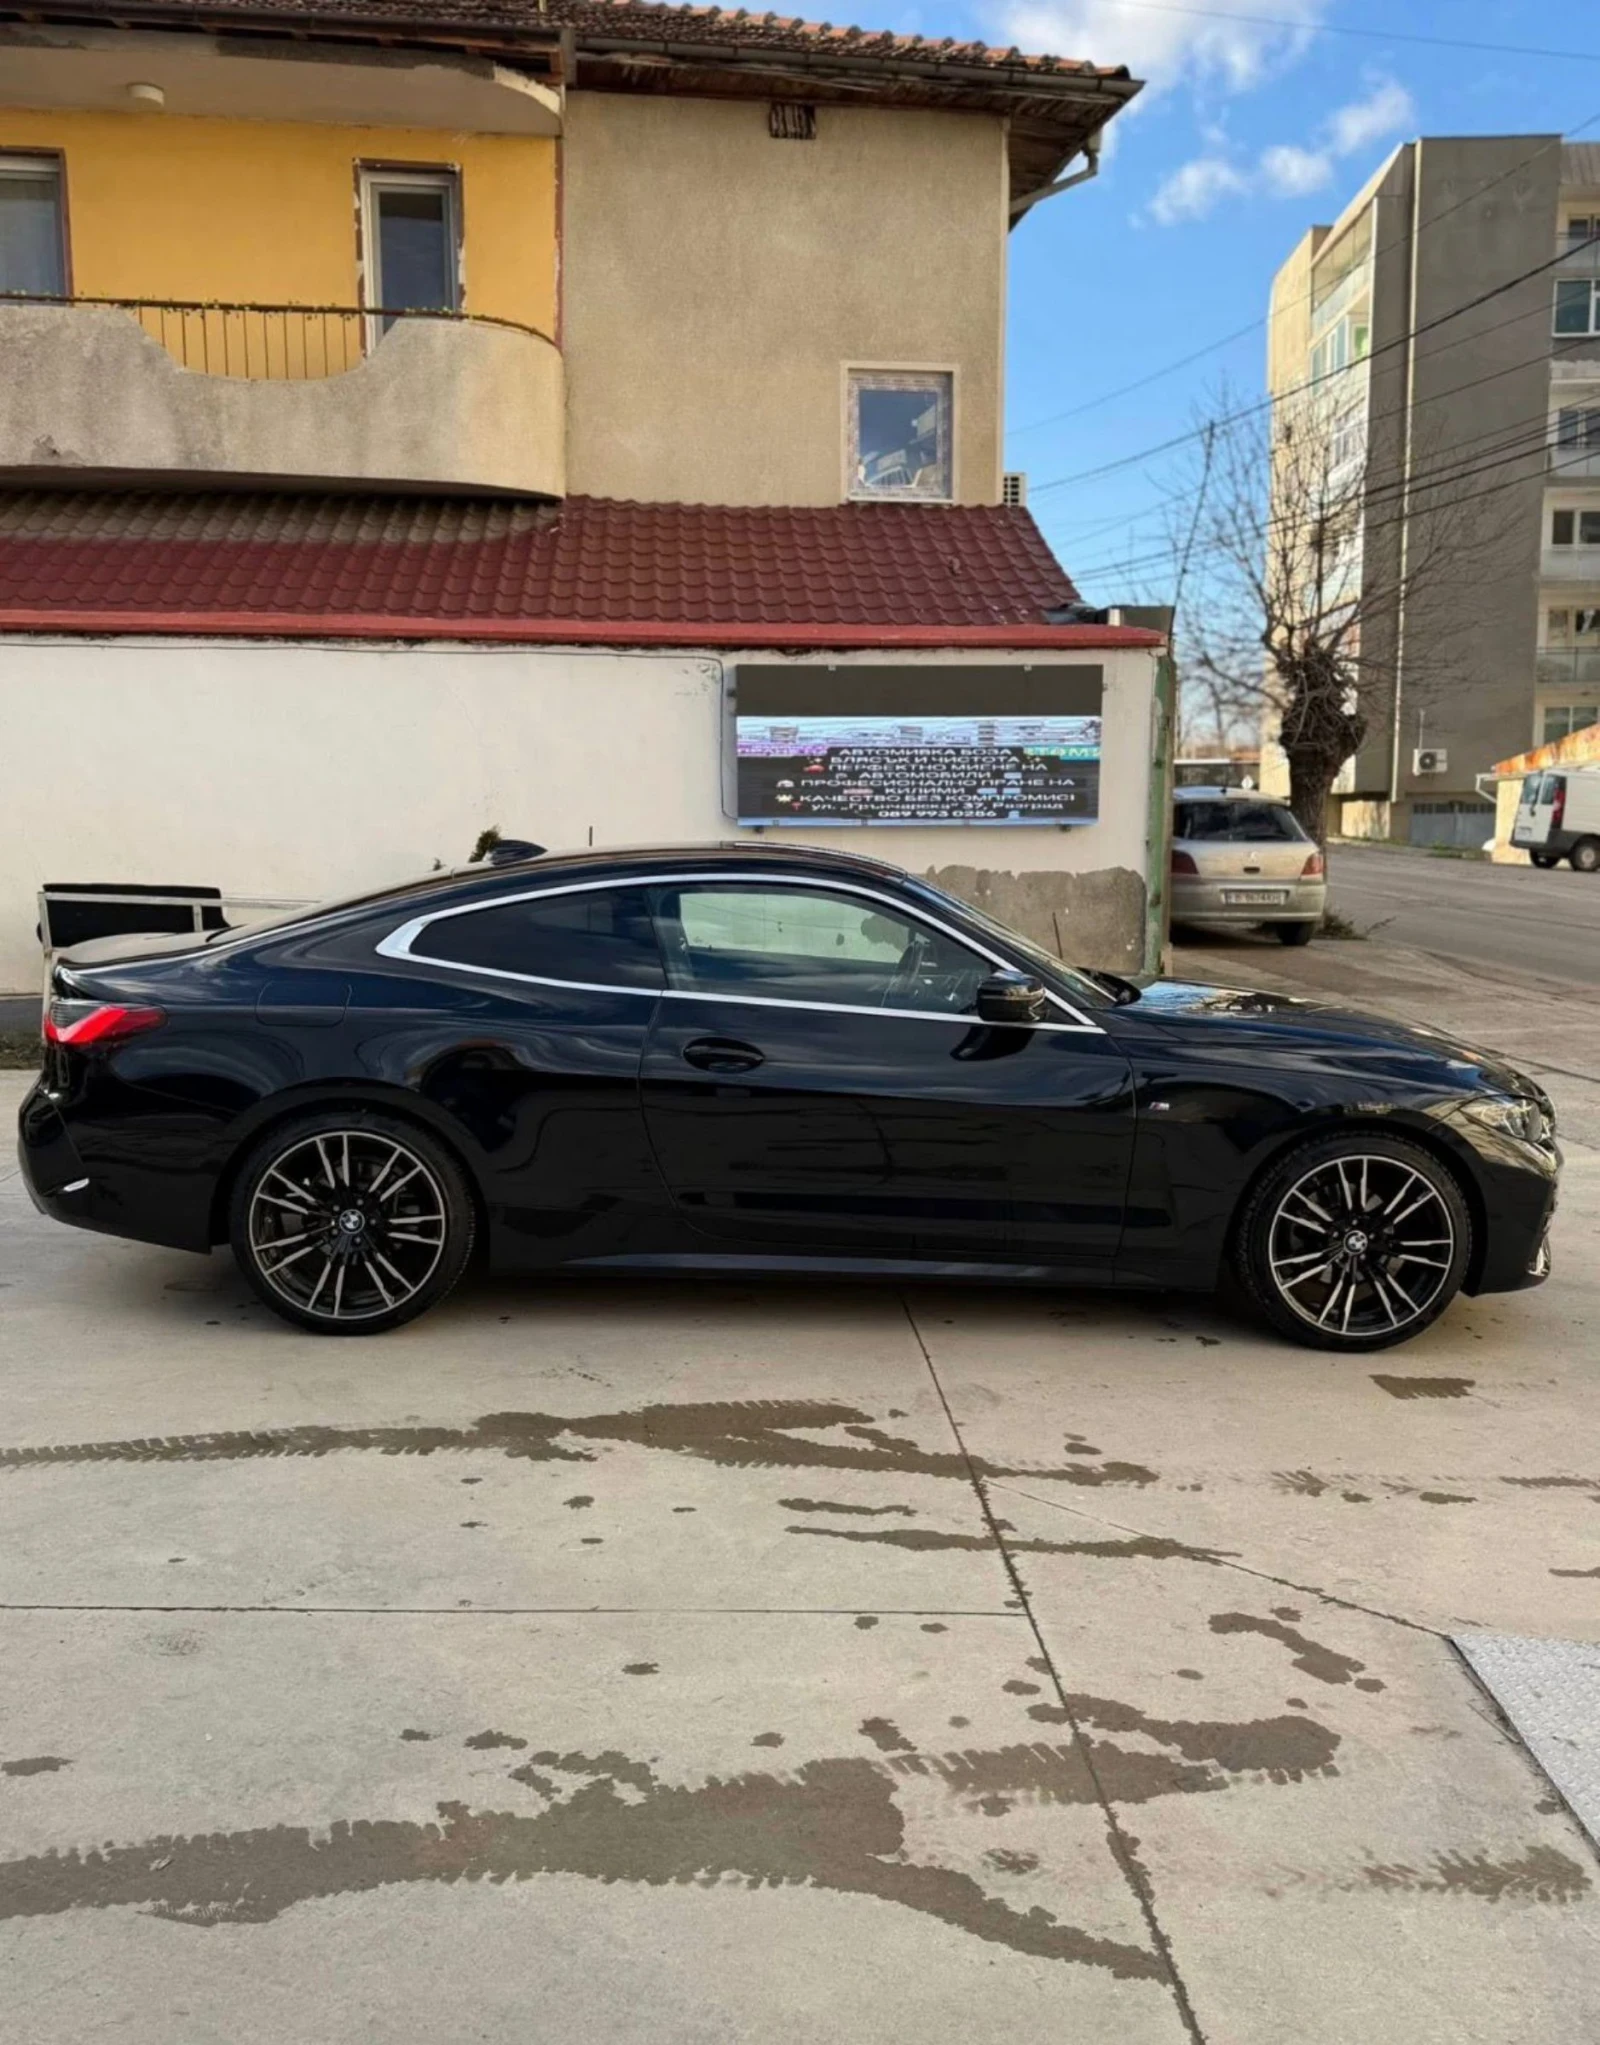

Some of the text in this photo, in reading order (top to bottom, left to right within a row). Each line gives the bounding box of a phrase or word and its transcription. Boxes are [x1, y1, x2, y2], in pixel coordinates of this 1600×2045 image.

[839, 748, 956, 756] АВТОМИВКА
[914, 756, 927, 764] И
[931, 756, 1020, 764] ЧИСТОТА
[859, 771, 991, 779] АВТОМОБИЛИ
[800, 779, 977, 787] ПРОФЕСИОНАЛНО
